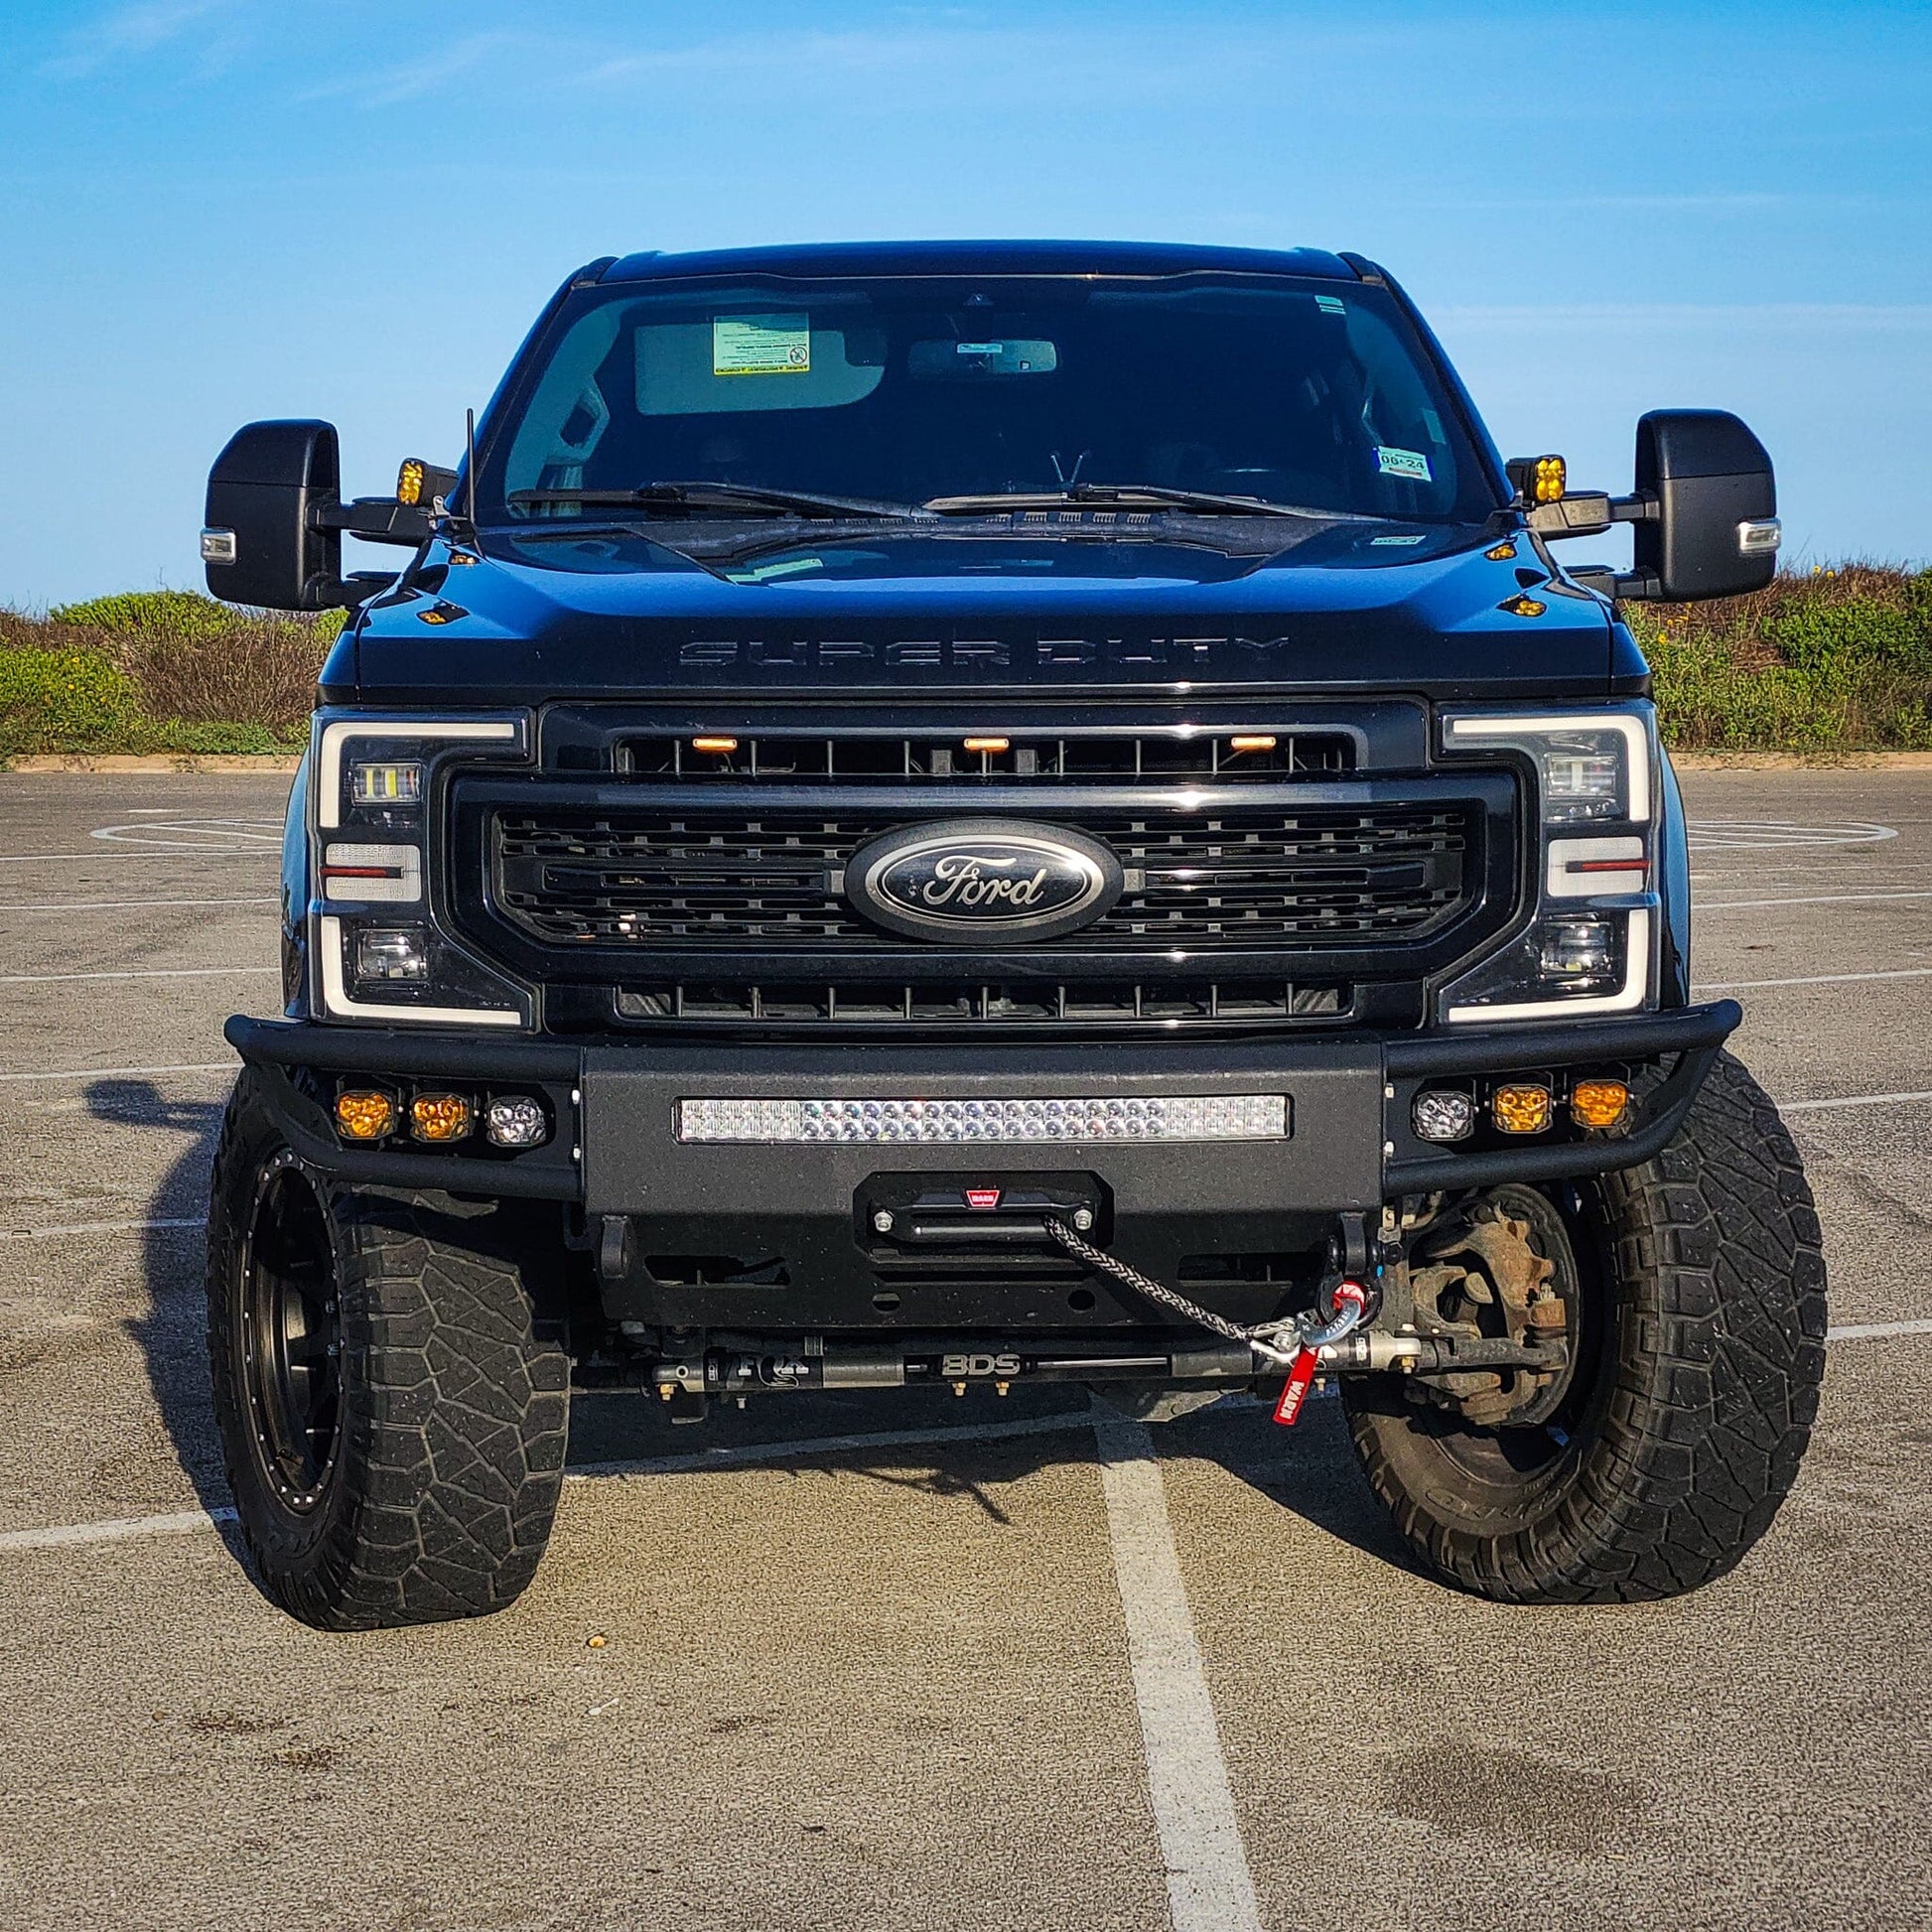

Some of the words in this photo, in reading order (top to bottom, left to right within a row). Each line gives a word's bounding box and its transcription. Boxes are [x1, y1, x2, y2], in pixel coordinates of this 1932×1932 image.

[679, 641, 1010, 665] SUPER
[1037, 636, 1290, 664] DUTY
[922, 854, 1047, 905] Ford
[942, 1353, 1021, 1376] BDS
[1279, 1380, 1306, 1420] WARN
